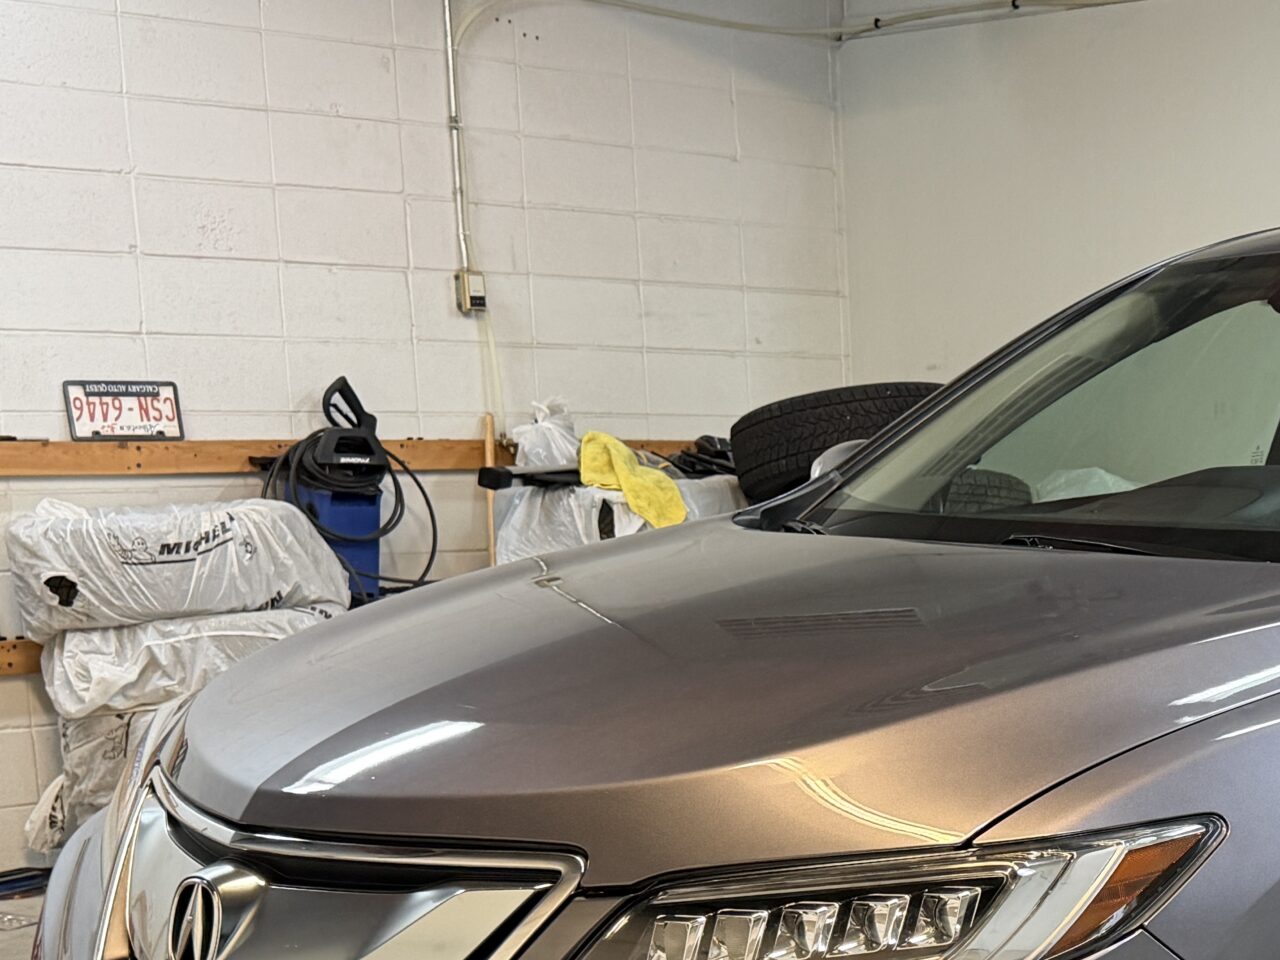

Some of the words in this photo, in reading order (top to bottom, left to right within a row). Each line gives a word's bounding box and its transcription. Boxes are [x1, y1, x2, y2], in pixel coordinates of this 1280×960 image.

[85, 383, 108, 393] QUEST
[108, 384, 127, 393] AUTO
[127, 384, 159, 393] CALGARY
